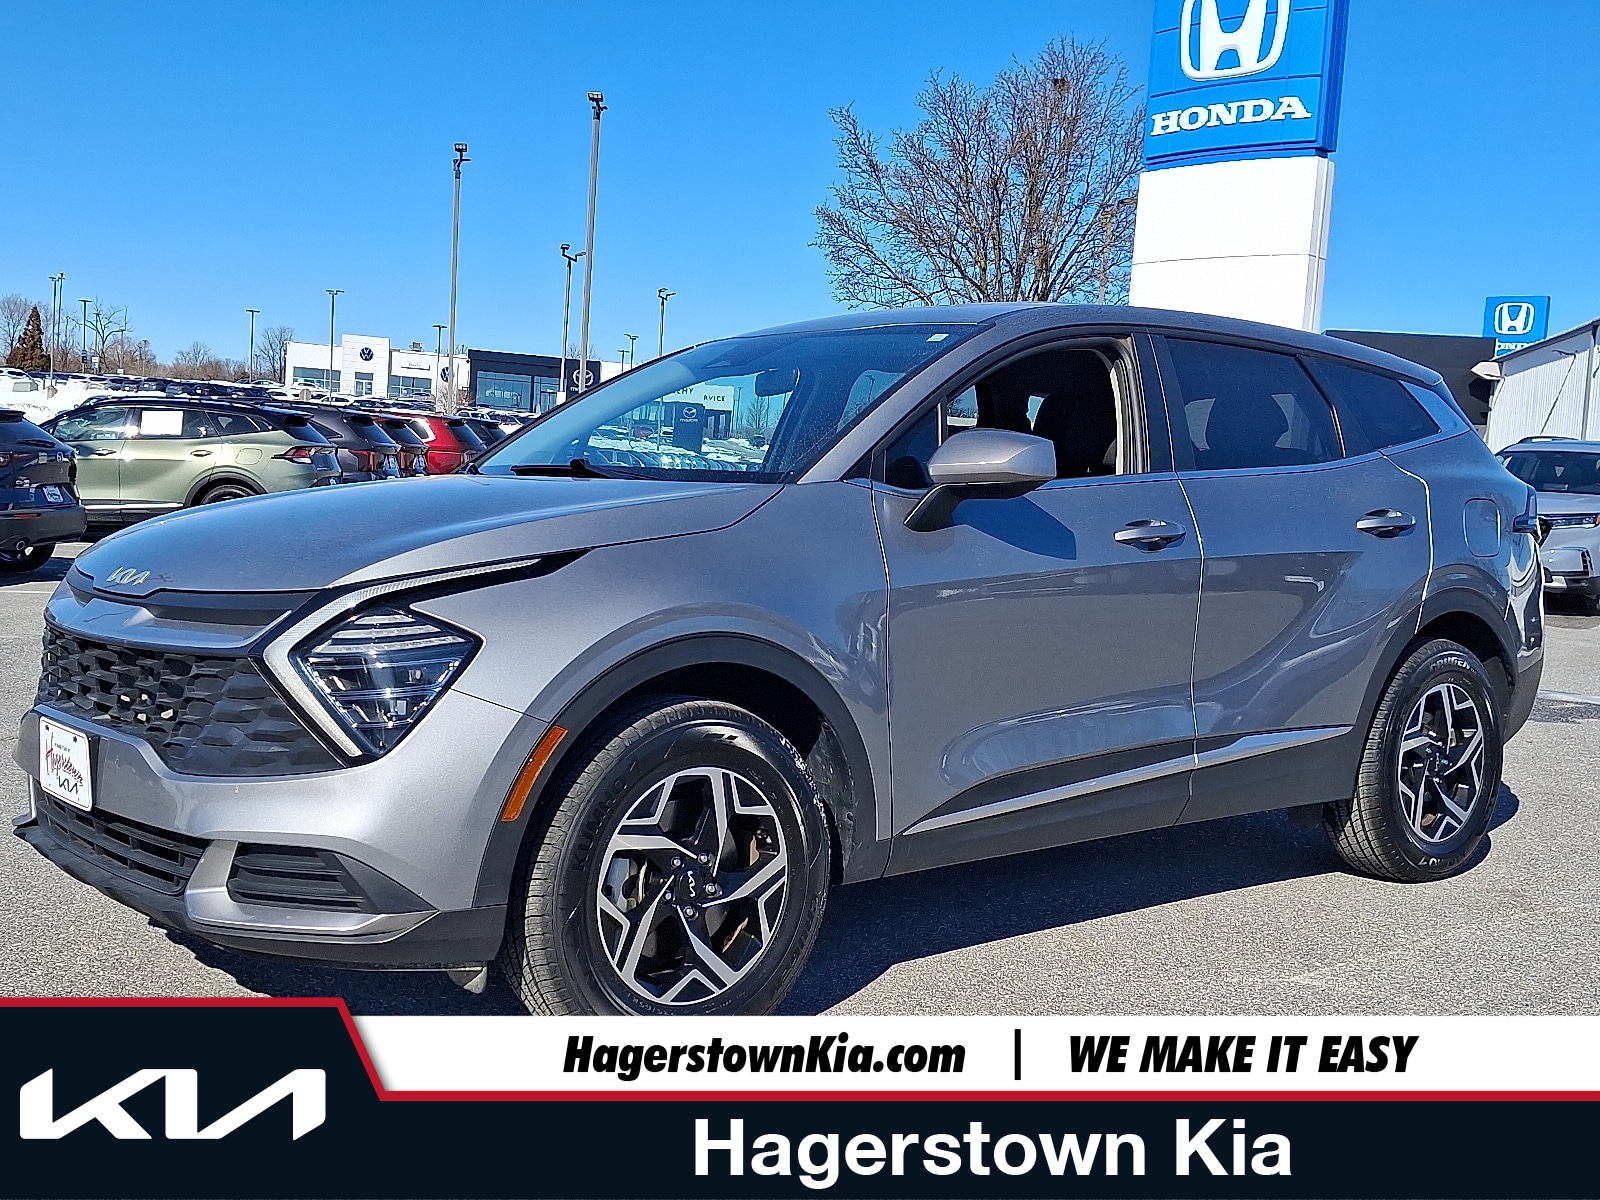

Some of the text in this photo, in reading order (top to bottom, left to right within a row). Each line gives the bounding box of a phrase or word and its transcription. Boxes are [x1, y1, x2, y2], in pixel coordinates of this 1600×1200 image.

[1150, 96, 1313, 136] HONDA
[106, 566, 151, 586] KIA
[58, 775, 79, 795] KIA
